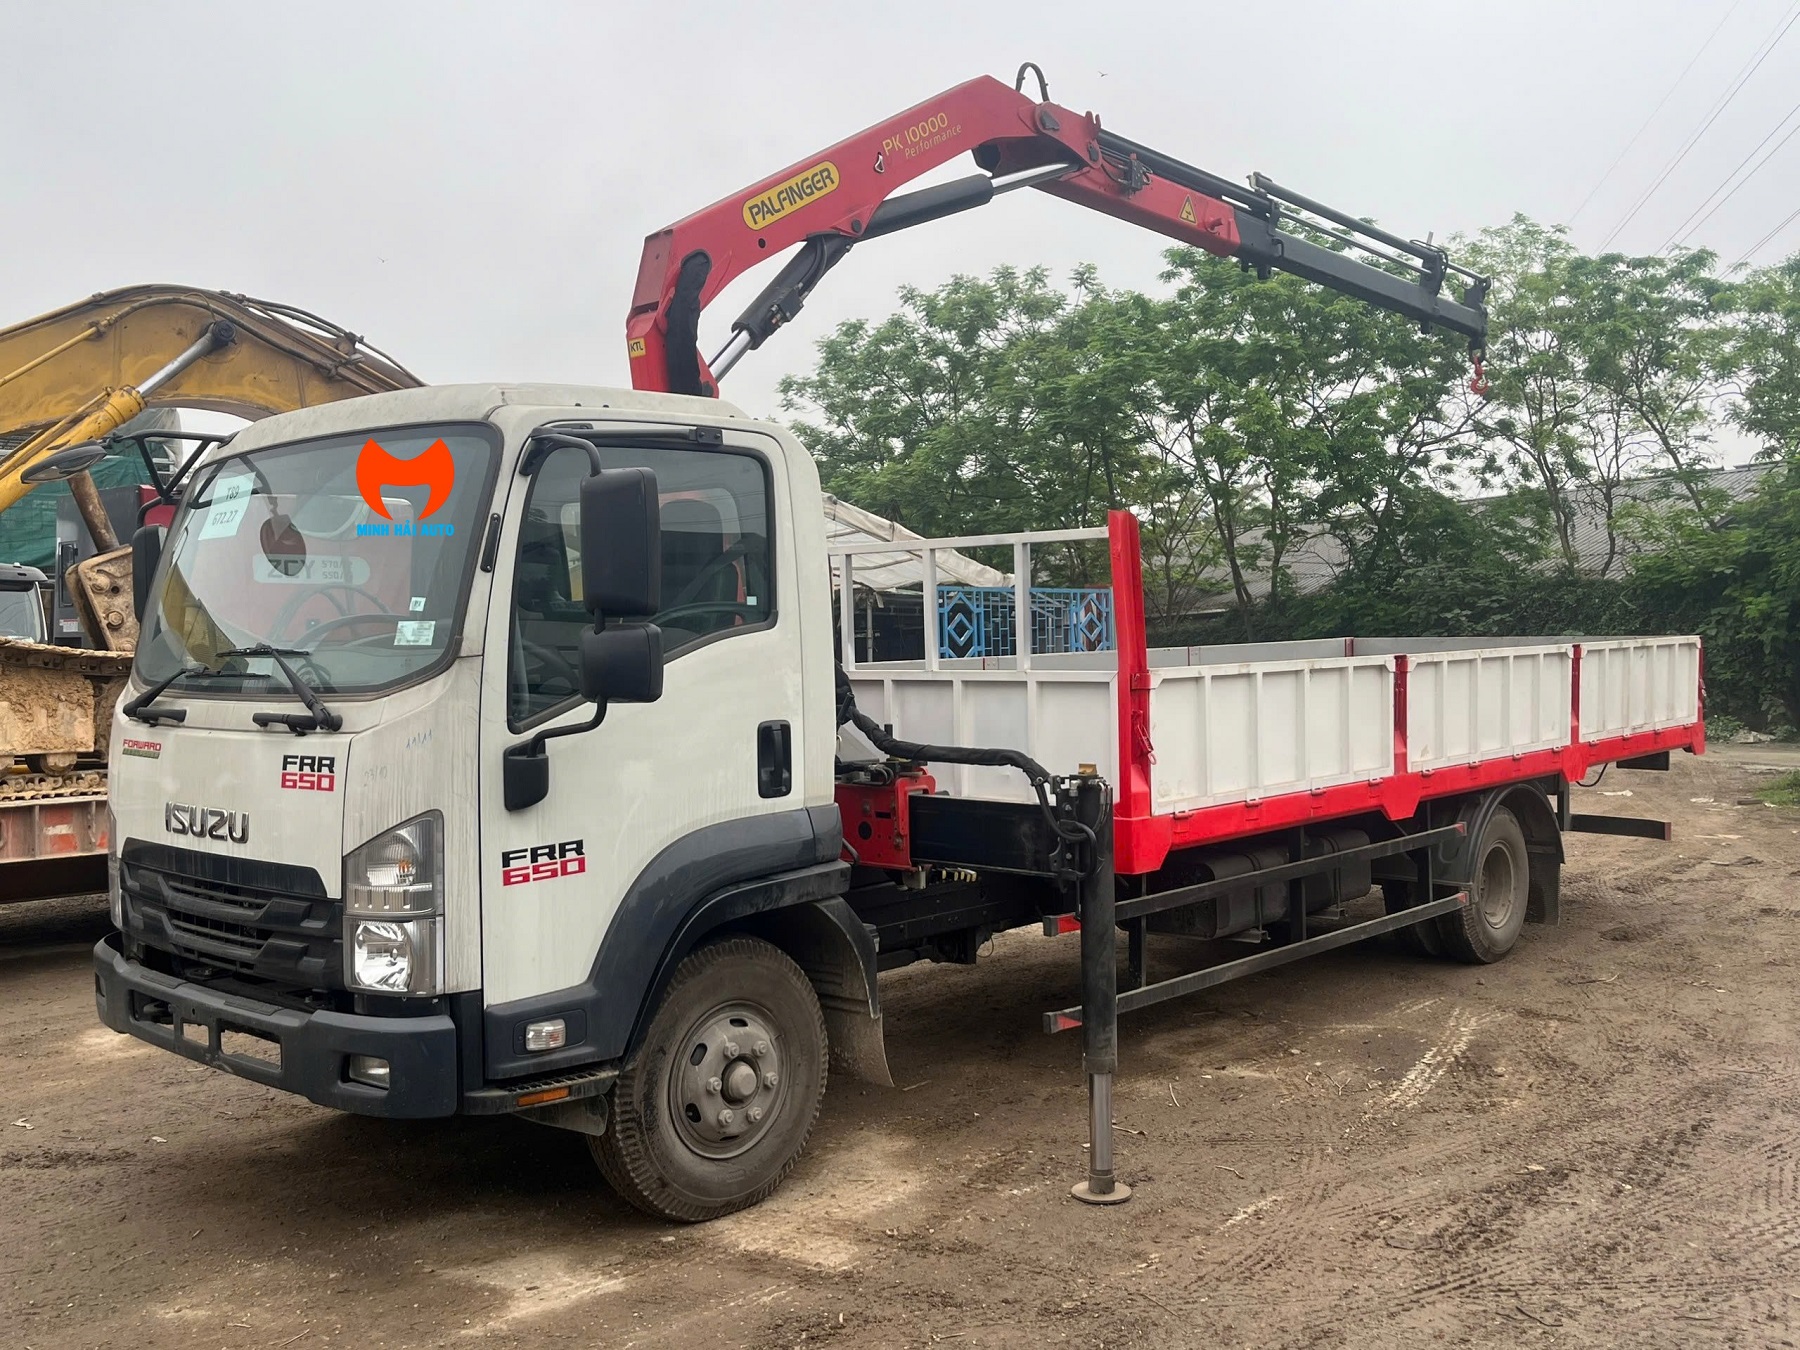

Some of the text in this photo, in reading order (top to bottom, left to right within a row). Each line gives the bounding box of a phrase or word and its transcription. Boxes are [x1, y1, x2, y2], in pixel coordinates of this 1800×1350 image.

[882, 112, 948, 156] PK 10000
[904, 123, 962, 159] Performance
[747, 166, 835, 226] PALFINGER
[630, 341, 644, 352] KTL
[123, 739, 162, 751] FORWARD
[282, 755, 335, 773] FRR
[281, 772, 335, 791] 650
[165, 801, 249, 844] ISUZU
[502, 839, 585, 869] FRR
[503, 857, 586, 886] 650
